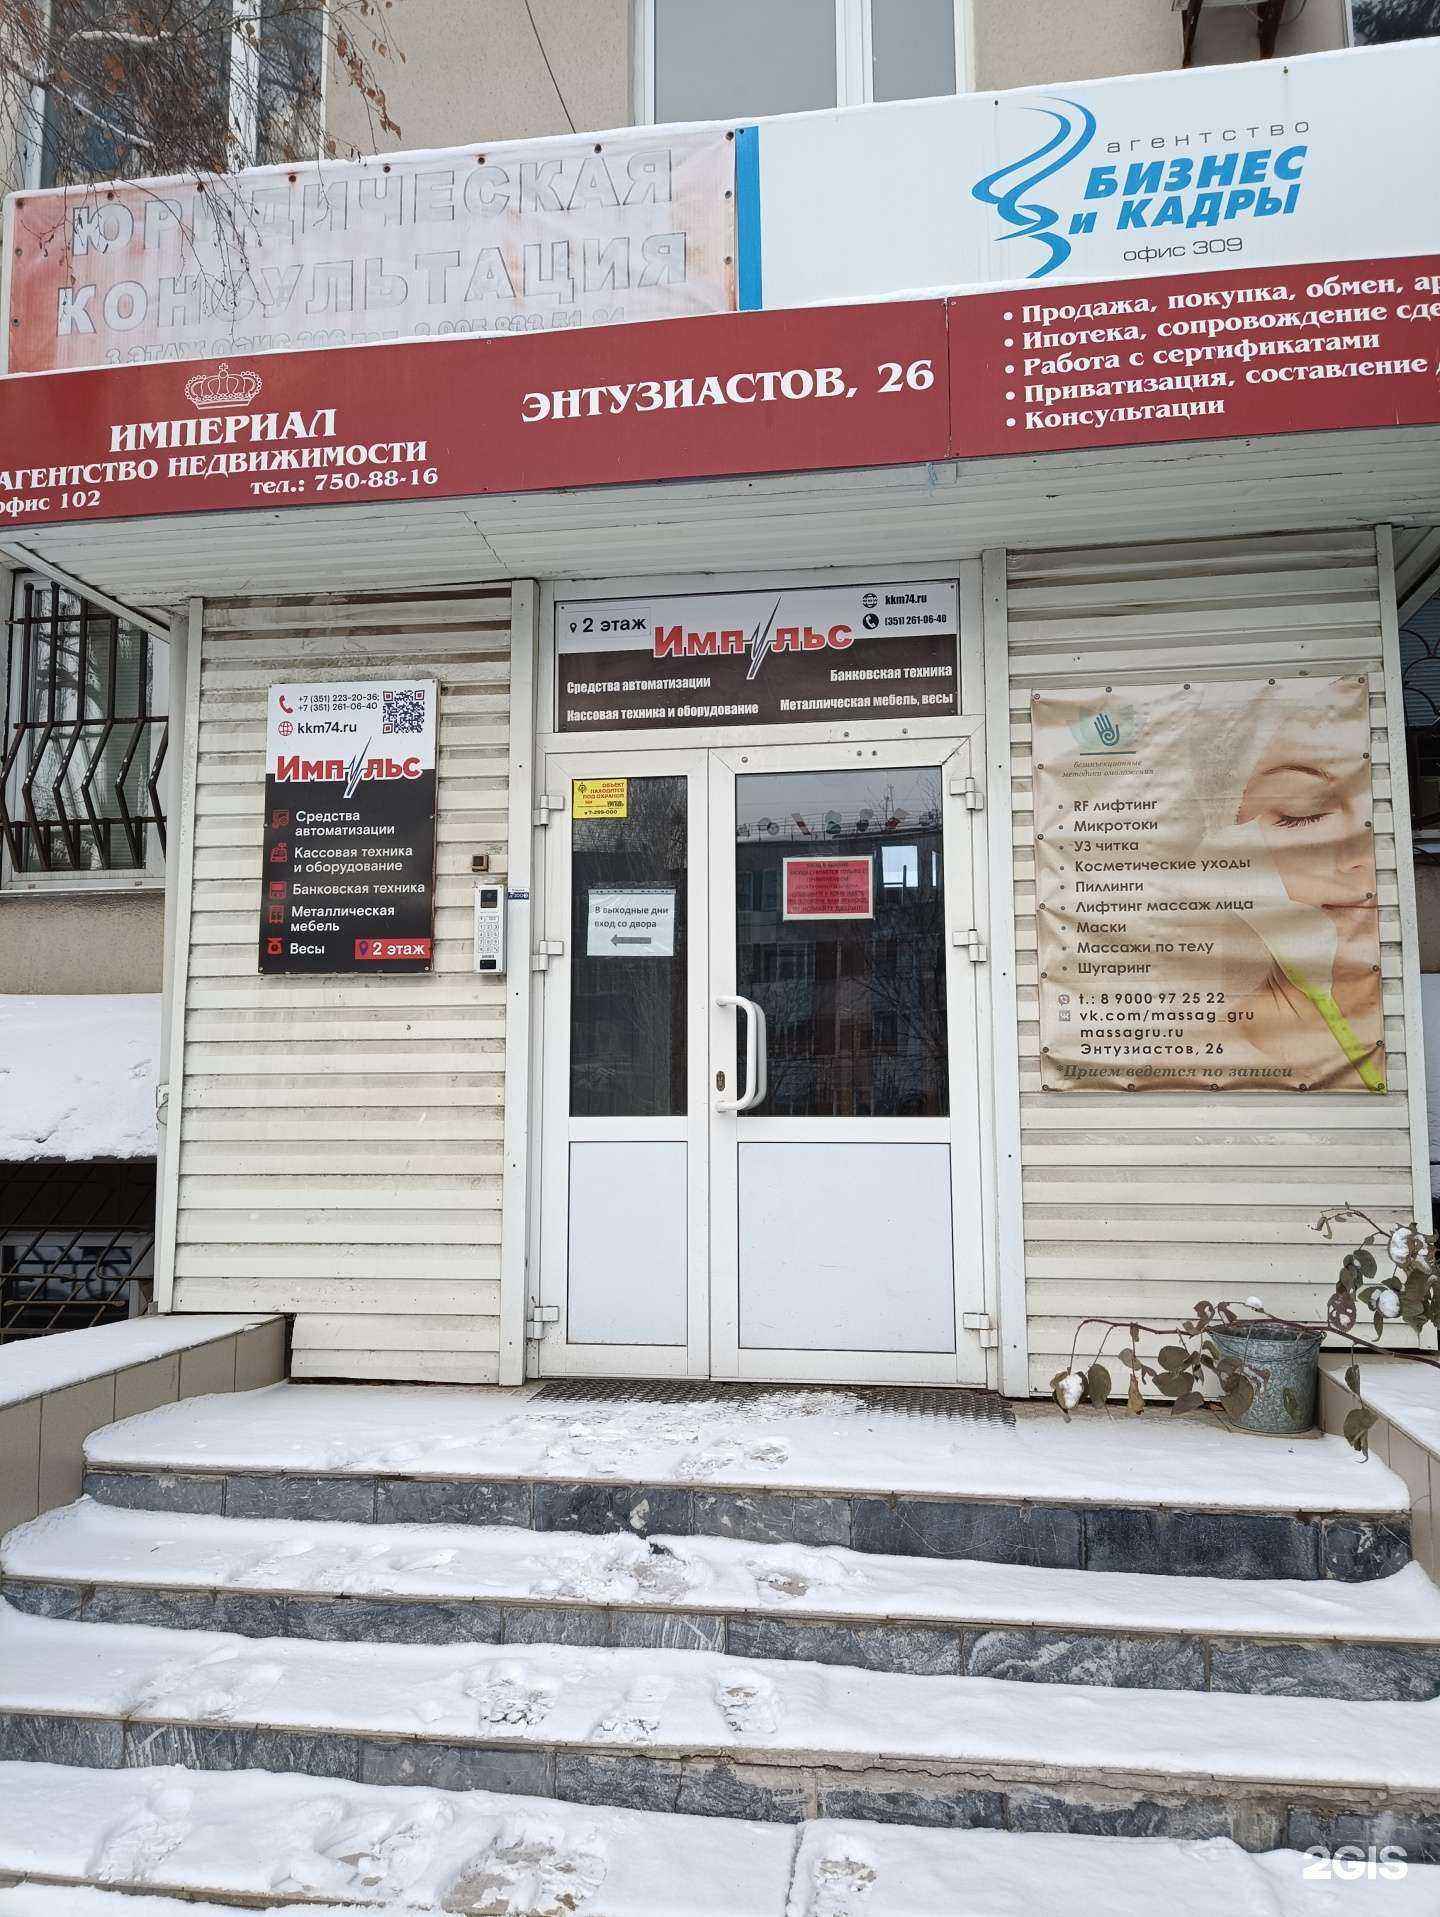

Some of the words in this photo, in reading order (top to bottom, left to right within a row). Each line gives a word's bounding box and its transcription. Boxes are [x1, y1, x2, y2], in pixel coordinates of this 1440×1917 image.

[1107, 121, 1309, 153] агентство
[1084, 146, 1307, 200] БИЗНЕС
[72, 148, 672, 256] ЮРИДИЧЕСКАЯ
[1069, 211, 1097, 235] и
[1117, 184, 1300, 230] КАДРЫ
[1123, 245, 1186, 263] офис
[1192, 237, 1243, 255] 309
[58, 232, 686, 336] КОНСУЛЬТАЦИЯ
[1022, 296, 1157, 326] Продажа,
[1168, 285, 1296, 311] покупка,
[1306, 274, 1403, 299] обмен,
[1022, 326, 1147, 350] Ипотека,
[1157, 305, 1387, 337] сопровождение
[1024, 351, 1120, 376] Работа
[1129, 351, 1144, 367] с
[1153, 332, 1381, 366] сертификатами
[1024, 370, 1235, 405] Приватизация,
[1245, 356, 1428, 384] составление
[521, 367, 858, 423] ЭНТУЗИАСТОВ,
[877, 360, 935, 393] 26
[1025, 399, 1225, 430] Консультации
[108, 408, 337, 453] ИМПЕРИАЛ
[0, 459, 158, 491] АГЕНТСТВО
[168, 441, 427, 478] НЕДВИЖИМОСТИ
[250, 477, 305, 495] тел.:
[315, 467, 439, 491] 750-88-16
[60, 490, 101, 509] 102
[885, 594, 927, 606] kkm74.ru
[582, 617, 594, 633] 2
[600, 618, 647, 632] этаж
[830, 668, 901, 682] Банковская
[903, 665, 953, 678] техника
[567, 680, 620, 694] Средства
[622, 677, 711, 692] автоматизации
[332, 701, 378, 711] 261-06-40
[780, 696, 870, 711] Металлическая
[873, 694, 920, 707] мебель,
[921, 693, 953, 705] весы
[567, 709, 619, 722] Кассовая
[621, 707, 666, 720] техника
[668, 706, 675, 718] и
[678, 703, 759, 719] оборудование
[297, 721, 357, 734] kkm74.ru
[1073, 800, 1089, 811] RF
[1093, 799, 1159, 813] лифтинг
[295, 810, 360, 824] Средства
[295, 825, 395, 837] автоматизации
[1073, 820, 1158, 834] Микротоки
[294, 847, 358, 859] Кассовая
[361, 846, 413, 858] техника
[1095, 840, 1139, 851] читка
[293, 864, 302, 873] и
[305, 861, 403, 875] оборудование
[1075, 859, 1197, 872] Косметические
[1200, 858, 1251, 872] уходы
[292, 883, 369, 895] Банковская
[373, 882, 425, 894] техника
[1075, 881, 1144, 893] Пиллинги
[291, 905, 395, 917] Металлическая
[602, 905, 649, 916] выходные
[651, 905, 668, 915] дни
[1075, 901, 1142, 915] Лифтинг
[1146, 900, 1211, 912] массаж
[1215, 899, 1254, 911] лица
[290, 920, 340, 932] мебель
[617, 919, 628, 928] со
[629, 919, 657, 930] двора
[1076, 922, 1127, 933] Маски
[290, 943, 325, 955] Весы
[372, 942, 382, 955] 2
[386, 942, 425, 955] этаж
[1077, 942, 1151, 954] Массажи
[1155, 943, 1175, 953] по
[1178, 942, 1214, 955] телу
[1078, 962, 1152, 976] Шугаринг
[1100, 993, 1109, 1005] 8
[1114, 993, 1153, 1005] 9000
[1158, 992, 1176, 1004] 97
[1182, 992, 1200, 1004] 25
[1206, 992, 1225, 1004] 22
[1079, 1009, 1254, 1023] vk.com/massag_gru
[1080, 1027, 1184, 1040] massagru.ru
[1080, 1043, 1200, 1057] Энтузиастов,
[1205, 1042, 1224, 1055] 26
[1126, 1064, 1198, 1078] ведется
[1202, 1068, 1224, 1078] по
[1228, 1067, 1293, 1078] записи
